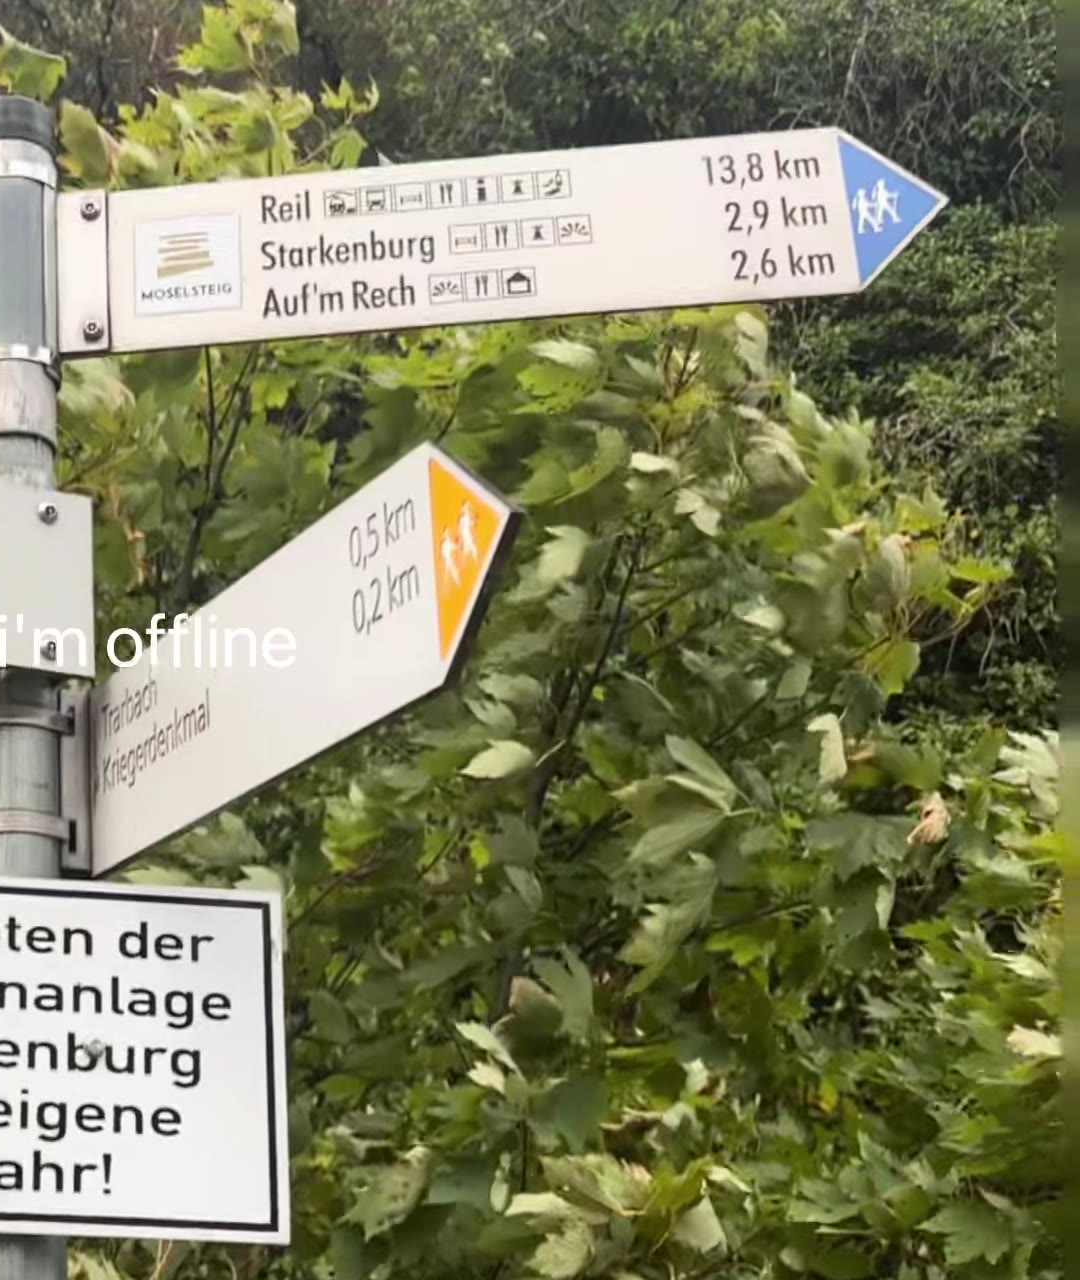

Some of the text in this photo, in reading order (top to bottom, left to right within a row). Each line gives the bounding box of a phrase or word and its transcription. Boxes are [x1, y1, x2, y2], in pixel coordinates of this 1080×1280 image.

[261, 149, 821, 223] Reil 13,8 km
[260, 195, 828, 270] Starkenburg 2,9 km
[141, 283, 232, 301] MOSELSTEIG
[262, 243, 836, 319] Auf'm Rech 2,6 km
[101, 498, 415, 741] Trarbach 0,5 km
[102, 564, 420, 795] Kriegerdenkmal 0,2 km
[118, 921, 214, 962] der
